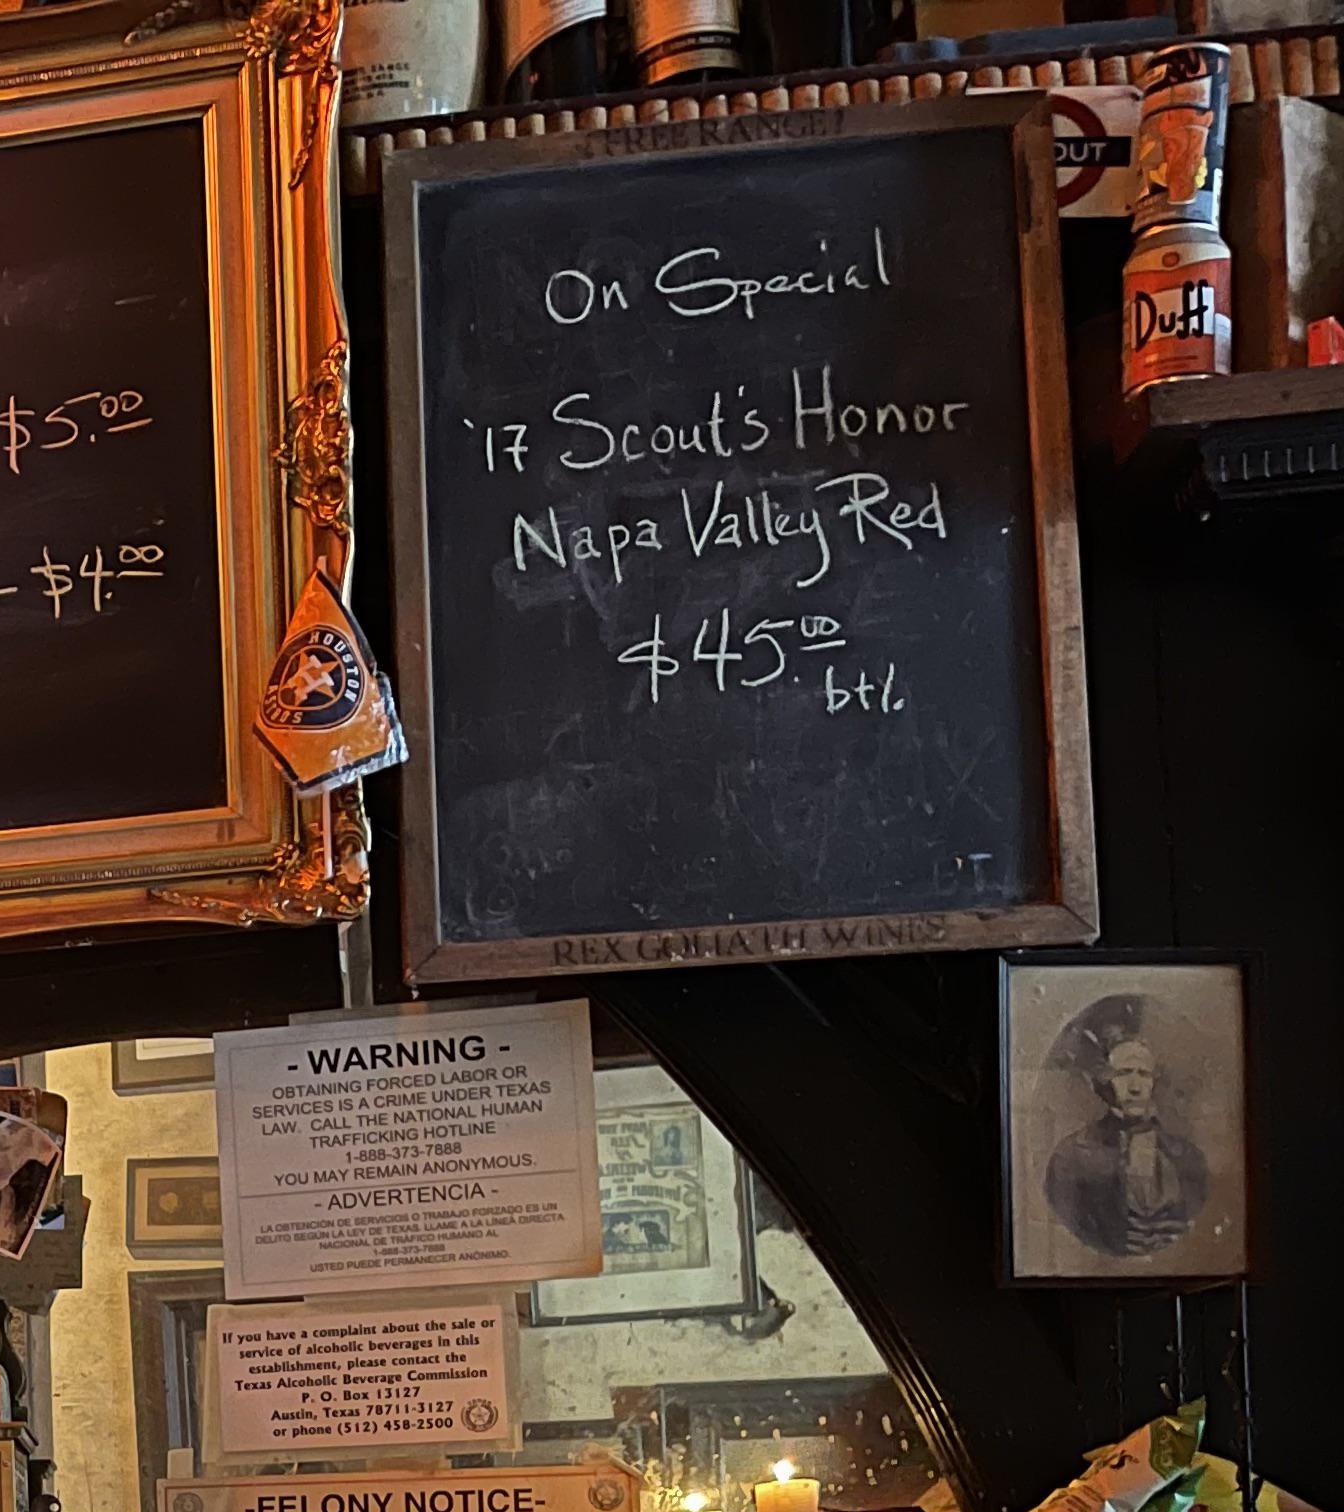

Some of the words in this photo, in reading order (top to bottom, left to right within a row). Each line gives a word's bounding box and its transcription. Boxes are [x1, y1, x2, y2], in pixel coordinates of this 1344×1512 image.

[545, 269, 628, 323] On
[655, 228, 889, 321] Special
[1134, 279, 1208, 351] Duff
[552, 385, 770, 470] Scout's
[792, 366, 968, 450] Honor
[512, 505, 663, 584] Napa
[683, 481, 829, 588] Valley
[815, 473, 947, 551] Red
[309, 631, 359, 702] HOUSTON
[552, 937, 640, 968] REX
[641, 923, 813, 962] GOLIATH
[821, 914, 948, 951] WINES
[308, 1035, 486, 1075] WARNING
[253, 1100, 333, 1119] SERVICES
[339, 1098, 353, 1113] IS
[358, 1096, 370, 1110] A
[374, 1091, 426, 1109] CRIME
[432, 1086, 491, 1103] UNDER
[497, 1080, 551, 1097] TEXAS
[272, 1080, 362, 1100] OBTAINING
[367, 1074, 436, 1091] FORCED
[441, 1067, 497, 1085] LABOR
[503, 1065, 527, 1080] OR
[310, 1114, 351, 1132] CALL
[356, 1112, 388, 1128] THE
[393, 1105, 476, 1124] NATIONAL
[482, 1100, 542, 1117] HUMAN
[310, 1128, 419, 1149] TRAFFICKING
[424, 1121, 496, 1139] HOTLINE
[346, 1142, 462, 1163] 1-888-373-7888
[275, 1172, 308, 1187] YOU
[312, 1168, 349, 1185] MAY
[354, 1162, 417, 1180] REMAIN
[422, 1154, 537, 1174] ANONYMOUS.
[328, 1184, 484, 1210] ADVERTENCIA
[235, 1378, 271, 1392] Texas
[276, 1375, 337, 1389] Alcoholic
[343, 1371, 402, 1387] Beverage
[408, 1366, 488, 1382] Commission
[271, 1408, 318, 1422] Austin,
[323, 1406, 361, 1419] Texas
[366, 1400, 453, 1418] 78711-3127
[273, 1426, 287, 1436] or
[292, 1422, 331, 1438] phone
[337, 1419, 378, 1435] (512)
[383, 1416, 453, 1432] 458-2500
